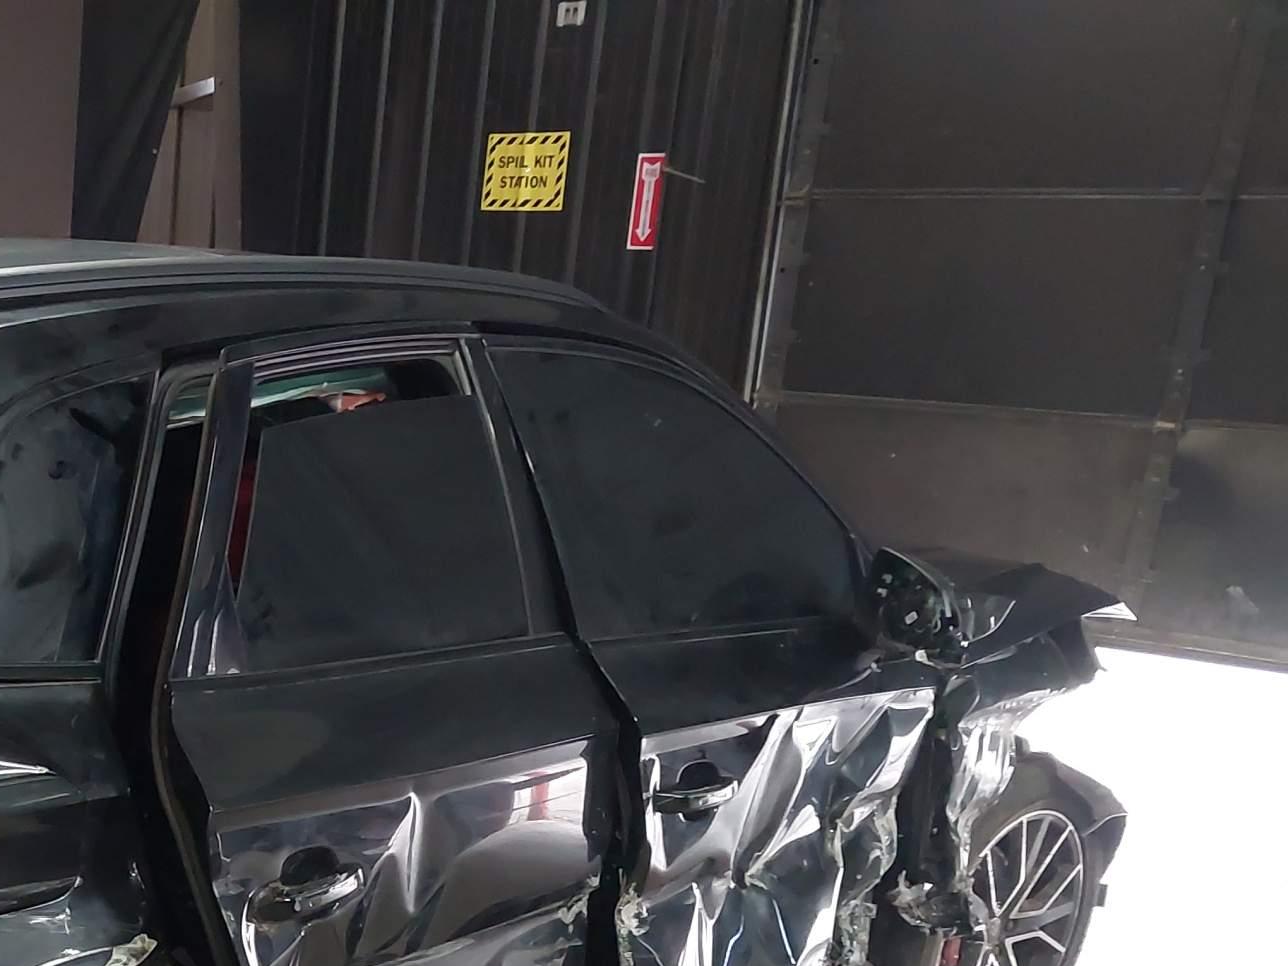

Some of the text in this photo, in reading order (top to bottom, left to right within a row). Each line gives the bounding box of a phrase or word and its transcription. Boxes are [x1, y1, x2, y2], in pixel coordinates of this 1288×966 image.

[498, 154, 554, 169] SPILL KIT
[500, 175, 548, 189] STATION
